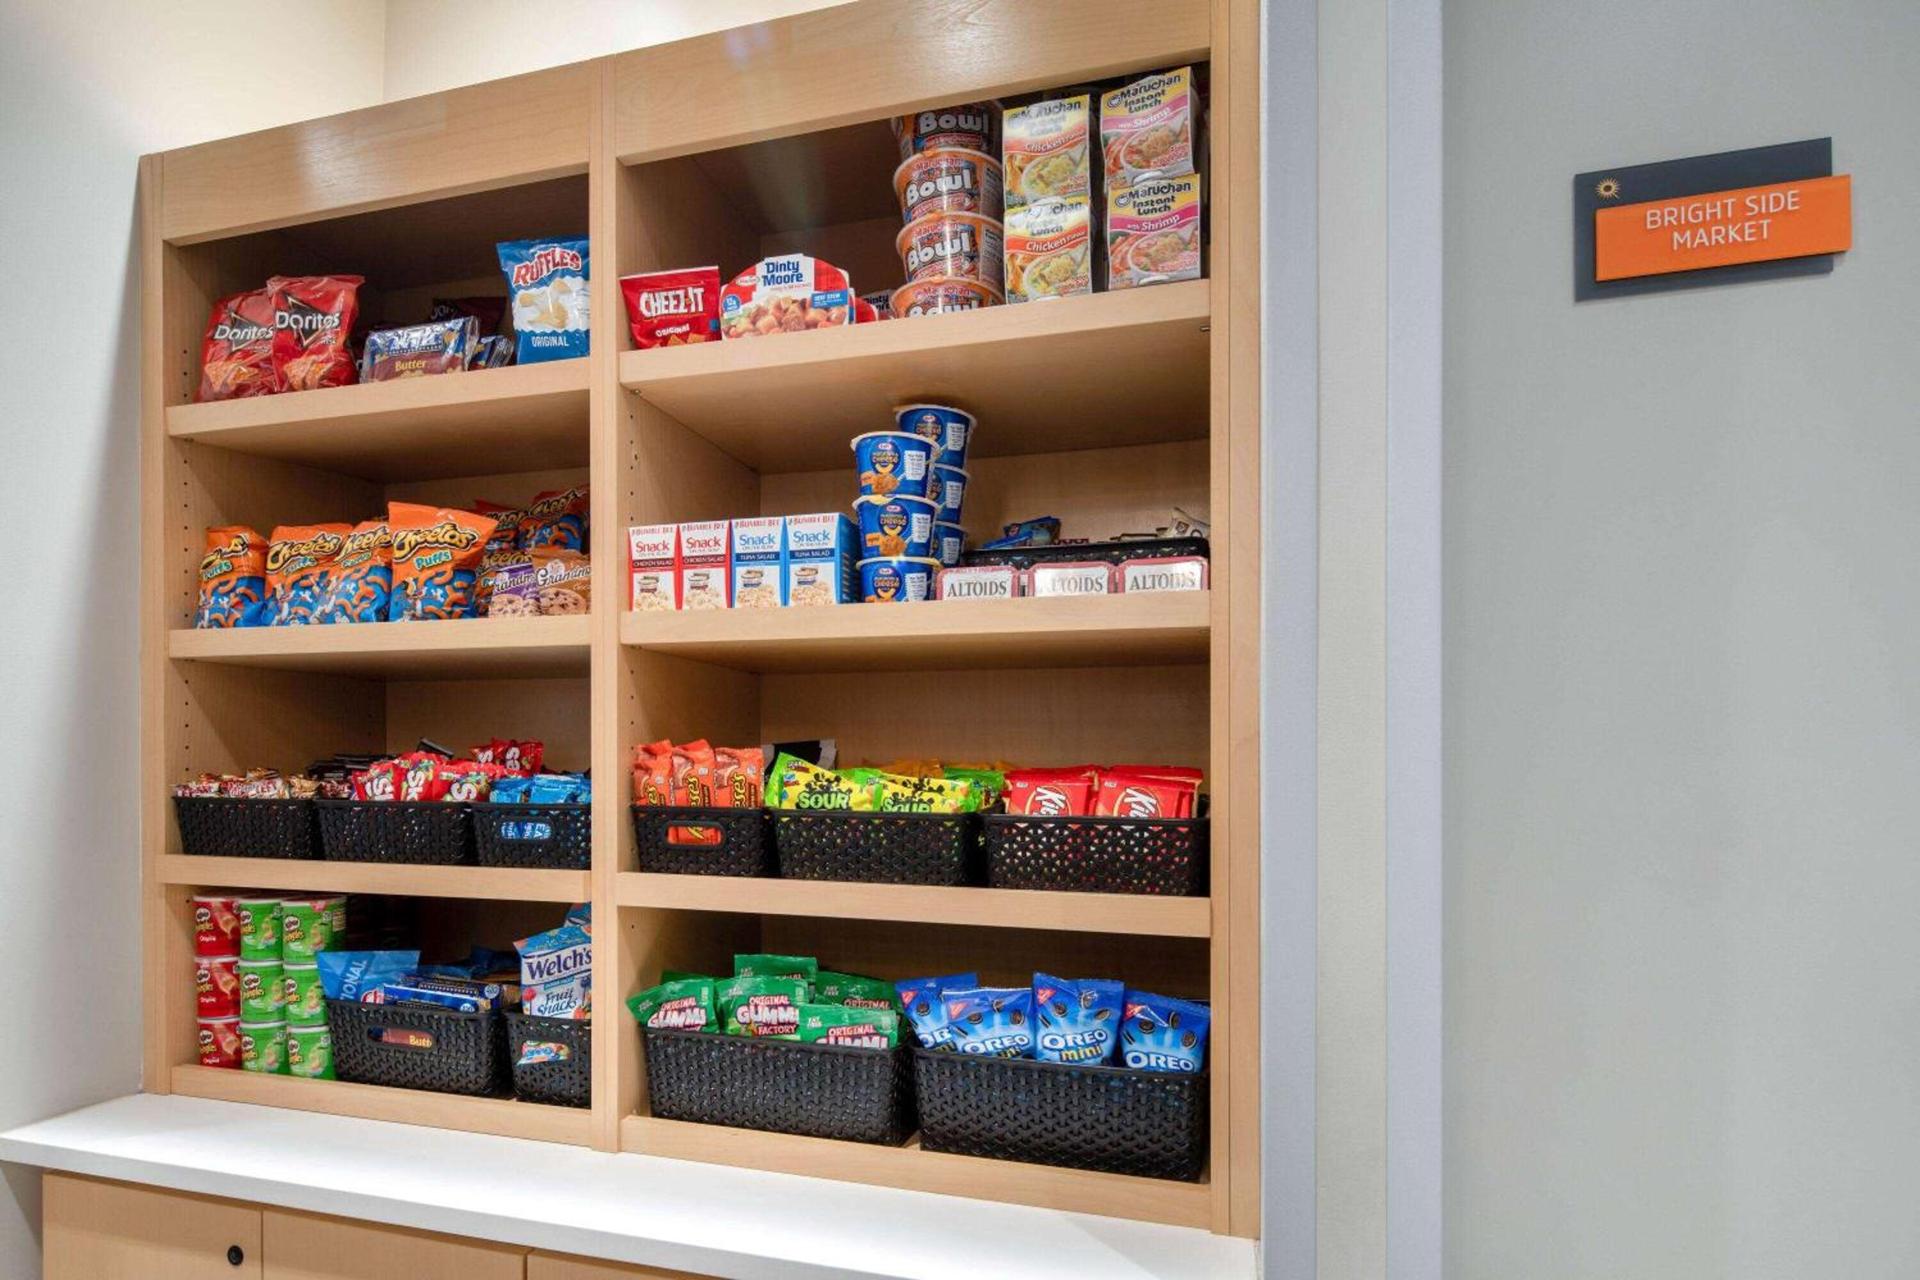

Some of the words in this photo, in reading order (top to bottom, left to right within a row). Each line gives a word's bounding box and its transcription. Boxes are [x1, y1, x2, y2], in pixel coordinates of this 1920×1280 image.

[1119, 75, 1181, 99] Maruchan
[1124, 89, 1165, 108] Instant
[1128, 100, 1162, 113] Lunch
[919, 111, 989, 134] Bowl
[906, 169, 972, 207] Bowl
[1129, 182, 1191, 199] Maruchan
[1132, 195, 1176, 209] Instant
[1137, 204, 1171, 215] Lunch
[1646, 198, 1736, 230] BRIGHT
[1745, 190, 1801, 216] SIDE
[1141, 214, 1180, 231] Shrimp
[1672, 219, 1771, 251] MARKET
[908, 232, 970, 272] Bowl
[1026, 238, 1067, 251] Chicken
[513, 247, 582, 286] RUFFLES
[765, 260, 800, 274] Dinty
[762, 272, 804, 286] Moore
[275, 311, 340, 330] Doritos
[214, 325, 273, 340] Doritos
[531, 336, 570, 347] ORIGINAL
[395, 359, 427, 372] Butter
[391, 523, 477, 561] Cheetos
[686, 536, 721, 549] Snack
[739, 533, 776, 545] Snack
[793, 529, 830, 543] Snack
[636, 540, 669, 553] Snack
[415, 550, 451, 570] Puffs
[948, 580, 1008, 597] ALTOIDS
[1130, 571, 1195, 591] ALTOIDS
[799, 790, 849, 809] SOUR
[527, 948, 592, 980] Welch's
[749, 996, 790, 1005] ORIGINAL
[843, 999, 891, 1009] ORIGINAL
[737, 1005, 800, 1024] GUMMI
[759, 1024, 797, 1035] FACTORY
[828, 1024, 876, 1036] ORIGINAL
[963, 1035, 1029, 1053] OREO
[1042, 1028, 1107, 1049] OREO
[1061, 1046, 1102, 1061] mini
[1125, 1051, 1194, 1071] OREO
